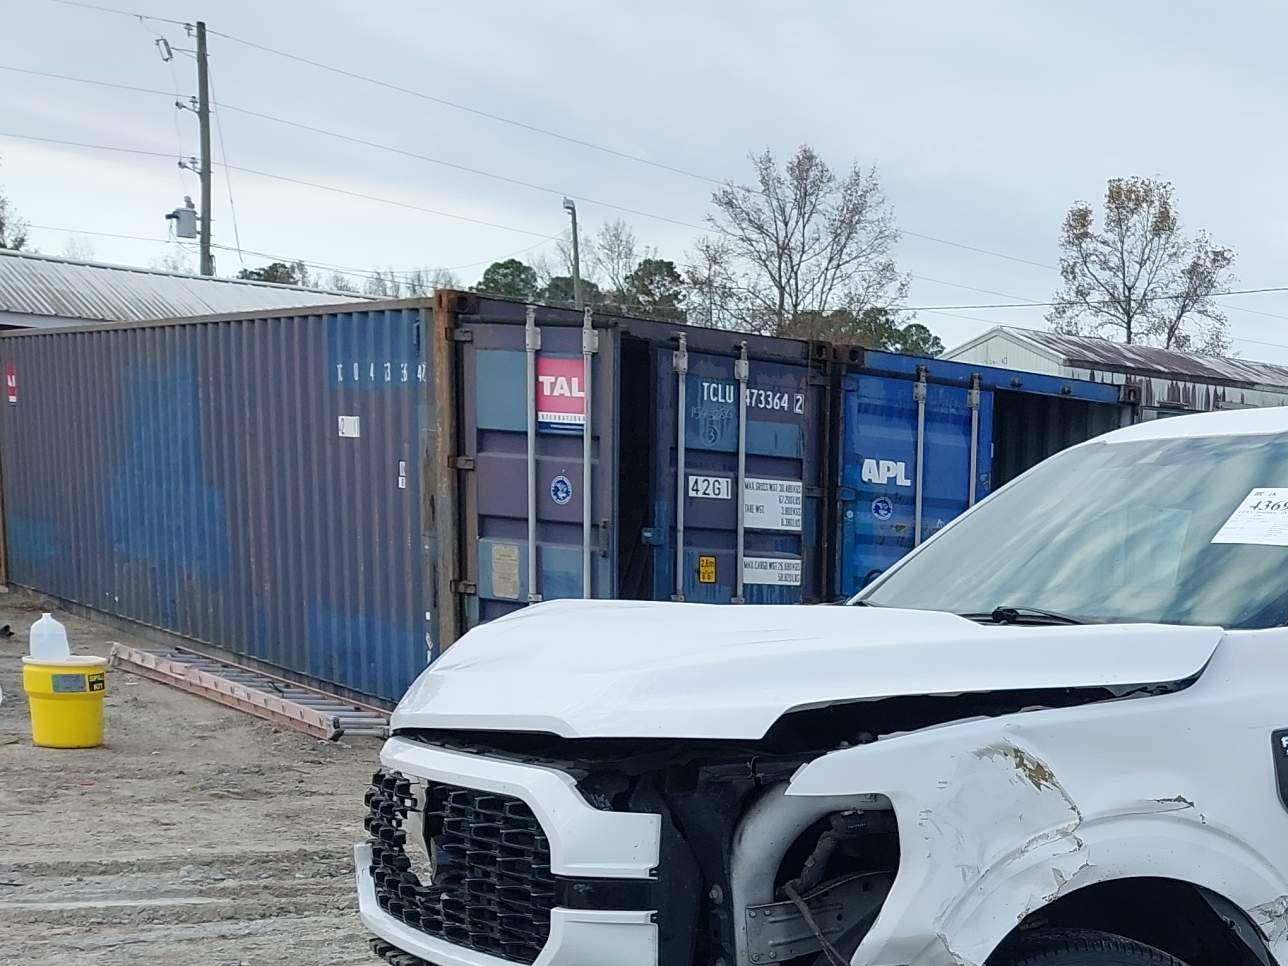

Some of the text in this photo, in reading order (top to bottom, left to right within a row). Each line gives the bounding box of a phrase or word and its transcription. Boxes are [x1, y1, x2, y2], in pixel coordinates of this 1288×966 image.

[539, 376, 585, 397] TAL
[702, 382, 803, 413] TCLU 473364 2
[861, 458, 912, 486] APL
[691, 478, 729, 497] 42G1
